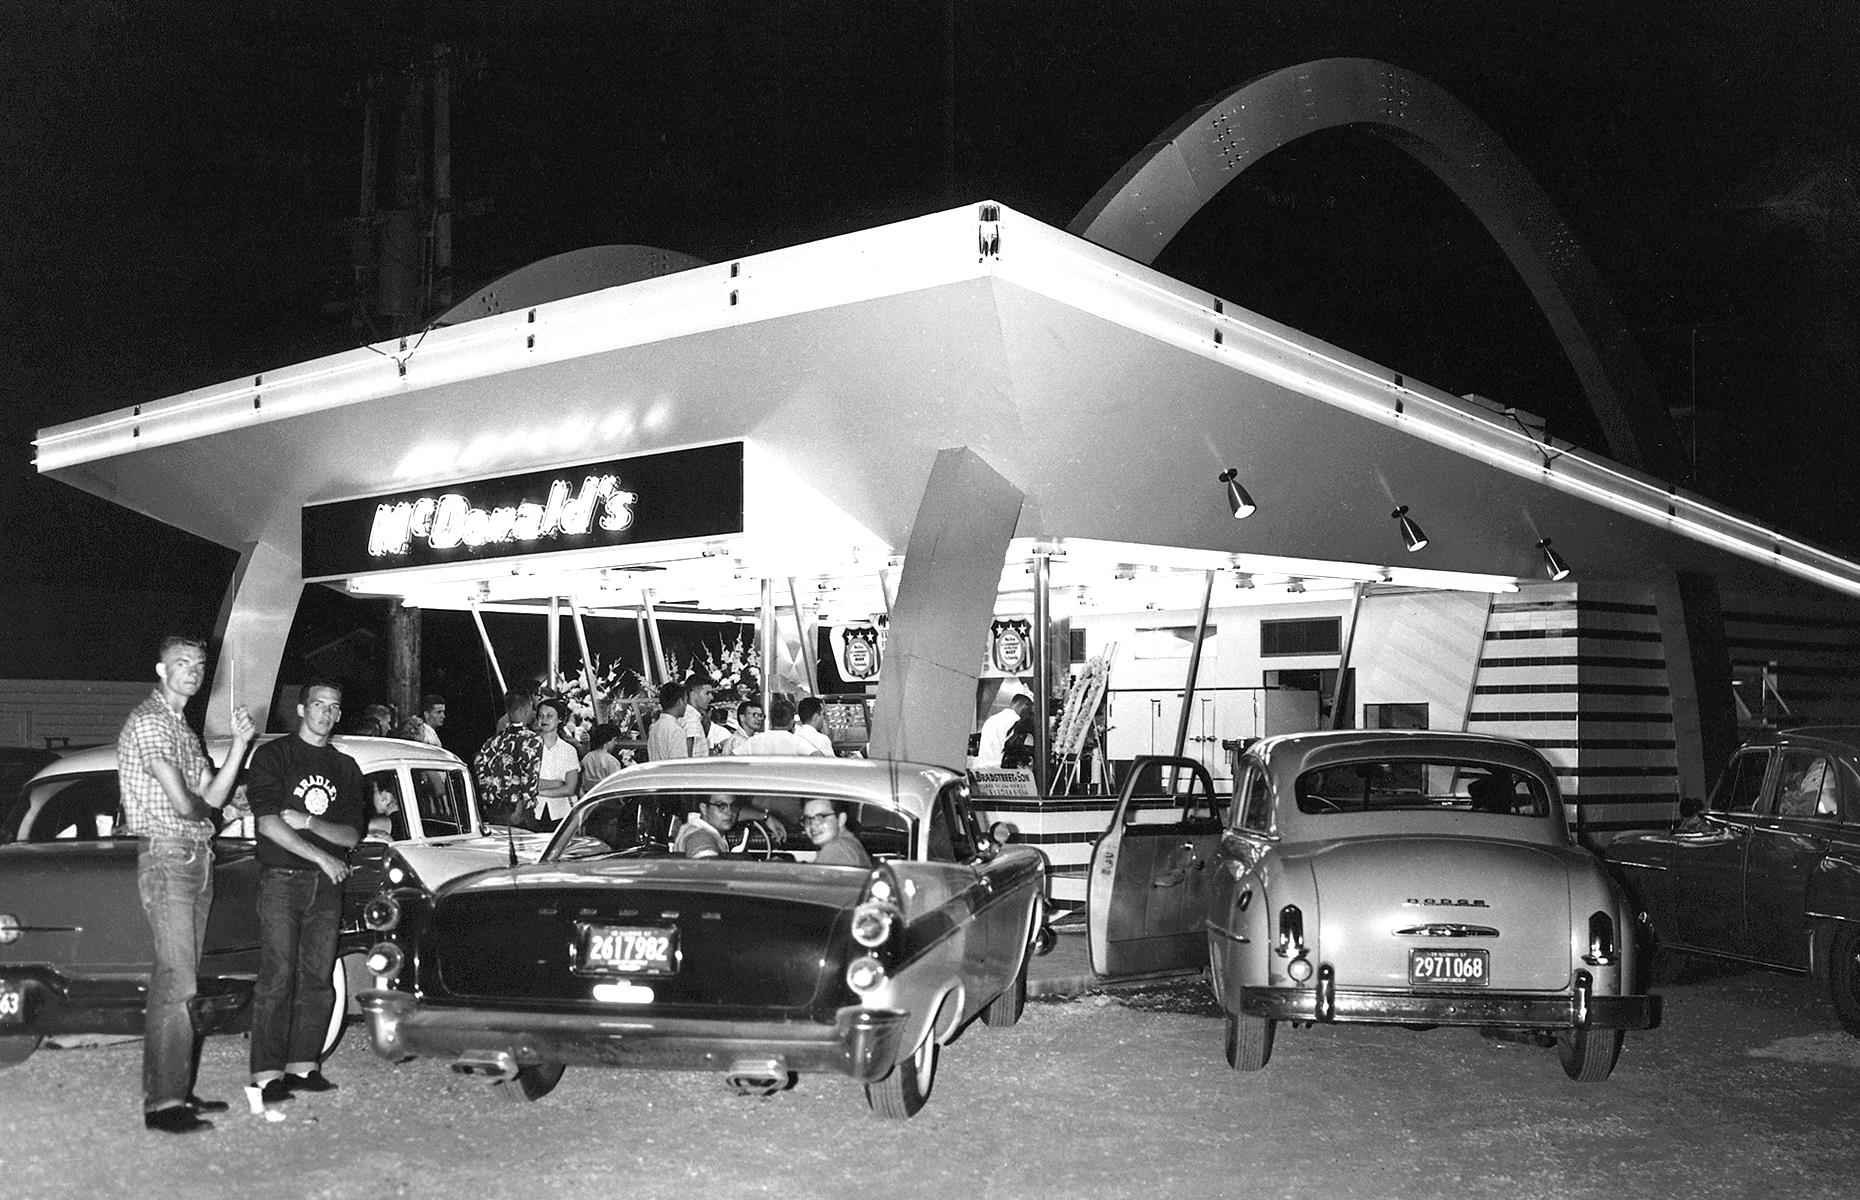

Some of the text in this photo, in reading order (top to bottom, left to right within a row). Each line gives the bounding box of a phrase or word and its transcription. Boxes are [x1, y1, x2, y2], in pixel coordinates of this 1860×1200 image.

[369, 474, 638, 556] McDonald's
[293, 775, 337, 801] BRADLEY
[590, 935, 669, 961] 2617982
[1415, 957, 1483, 978] 2971068
